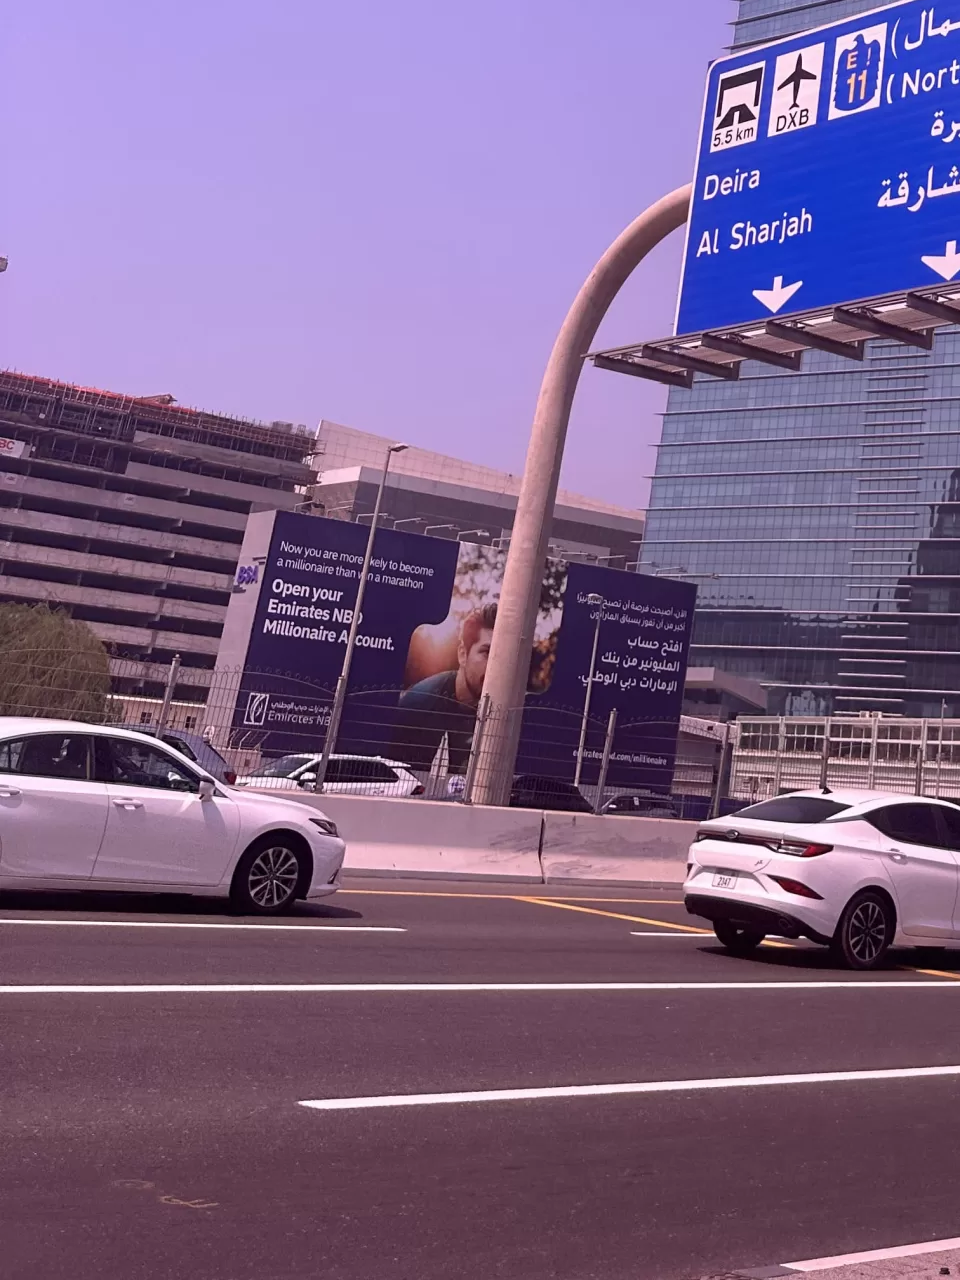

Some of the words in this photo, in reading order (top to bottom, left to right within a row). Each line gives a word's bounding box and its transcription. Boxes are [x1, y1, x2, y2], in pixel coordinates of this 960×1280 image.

[846, 53, 857, 70] E
[846, 70, 868, 105] 11
[775, 108, 810, 133] DXB
[713, 130, 734, 148] 5.5
[735, 124, 754, 142] km
[703, 169, 761, 201] Deira
[696, 230, 719, 257] Al
[729, 208, 813, 251] Sharjah
[280, 540, 304, 555] Now
[304, 546, 322, 559] you
[322, 550, 339, 560] are
[339, 553, 364, 565] more
[388, 560, 398, 571] to
[399, 561, 435, 577] become
[276, 557, 284, 567] a
[284, 558, 335, 575] millionaire
[335, 565, 356, 579] than
[374, 573, 381, 583] a
[382, 575, 424, 590] marathon
[272, 578, 310, 598] Open
[311, 587, 344, 602] your
[267, 598, 330, 621] Emirates
[263, 618, 337, 642] Millionaire
[338, 629, 395, 651] Acount.
[627, 636, 660, 649] حساب
[601, 651, 620, 668] بنك
[661, 641, 683, 656] افتح
[622, 655, 637, 668] من
[638, 657, 680, 673] المليونير
[620, 677, 637, 691] دبي
[639, 676, 678, 695] الإمارات
[268, 710, 314, 725] Emirates
